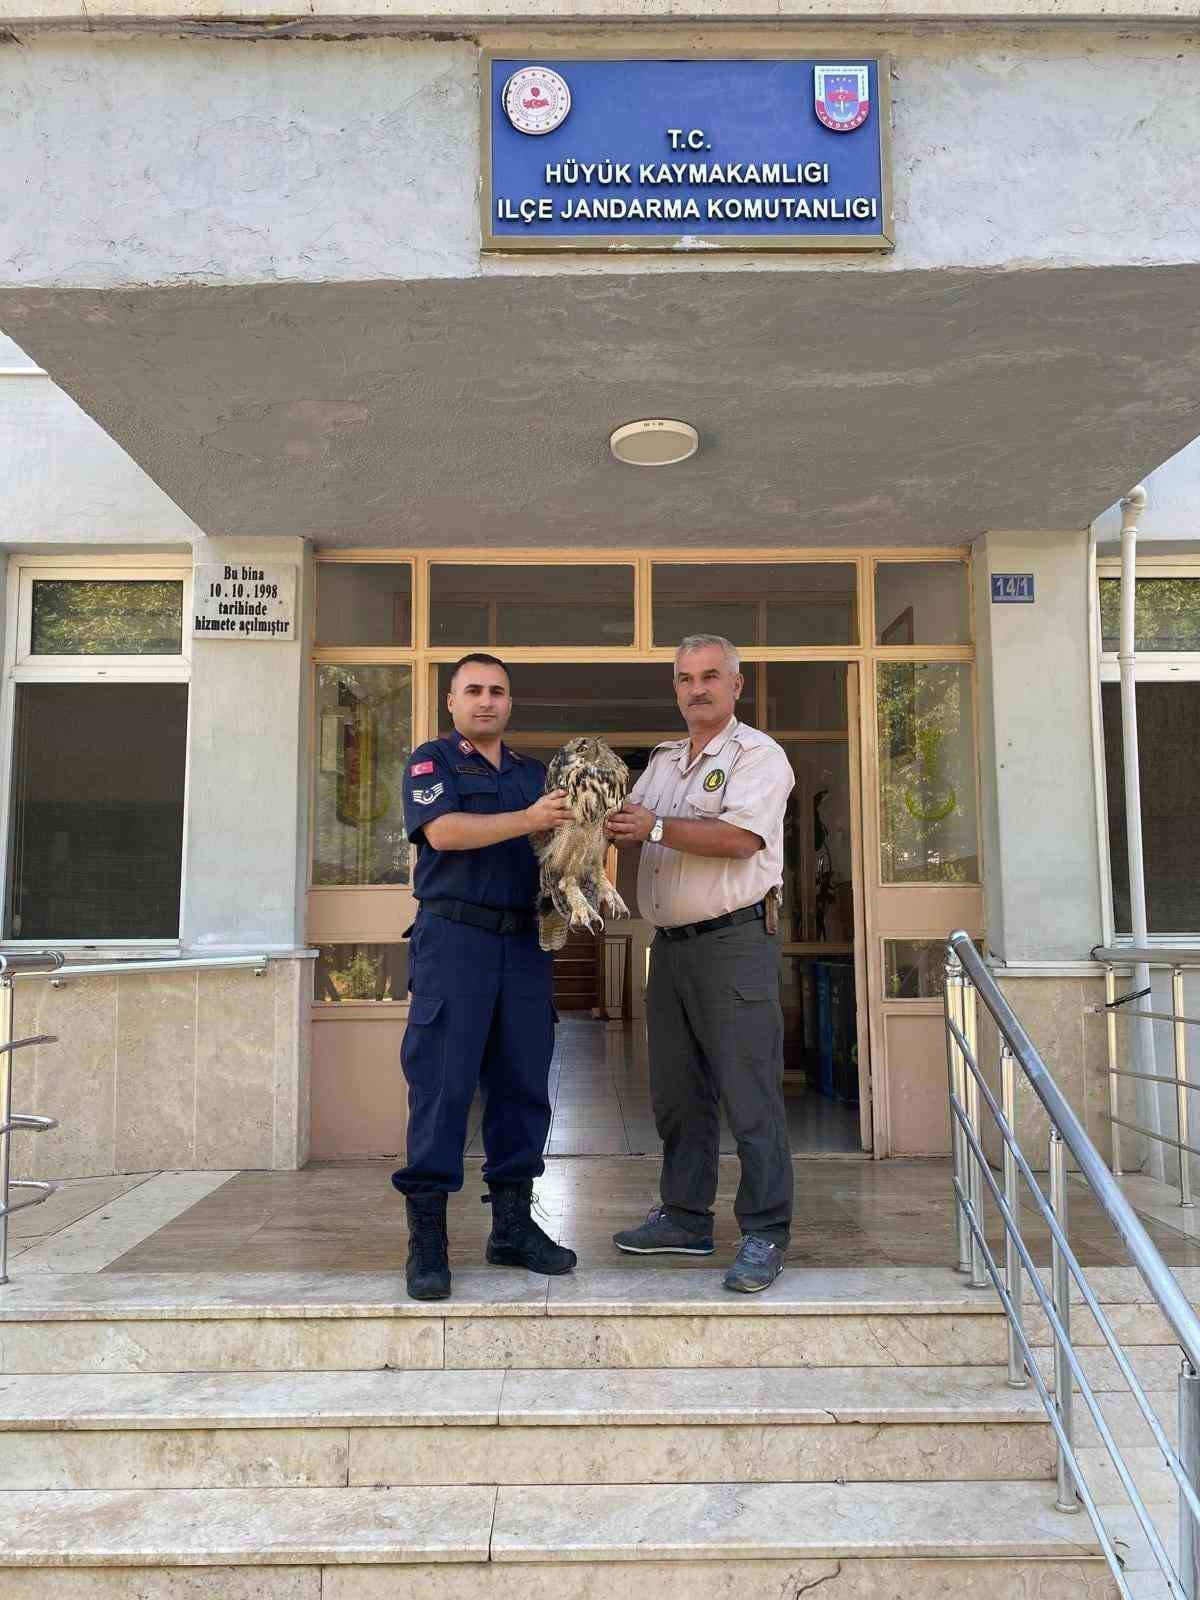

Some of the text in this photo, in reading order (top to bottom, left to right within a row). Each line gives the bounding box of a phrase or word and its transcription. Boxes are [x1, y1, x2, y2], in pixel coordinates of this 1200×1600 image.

[667, 129, 712, 149] T.C.
[560, 199, 701, 219] JANDARMA
[224, 565, 264, 581] Bu bina
[996, 576, 1028, 596] 14/1
[218, 601, 268, 616] tarihinde
[195, 616, 290, 636] hizmete açılmıştır
